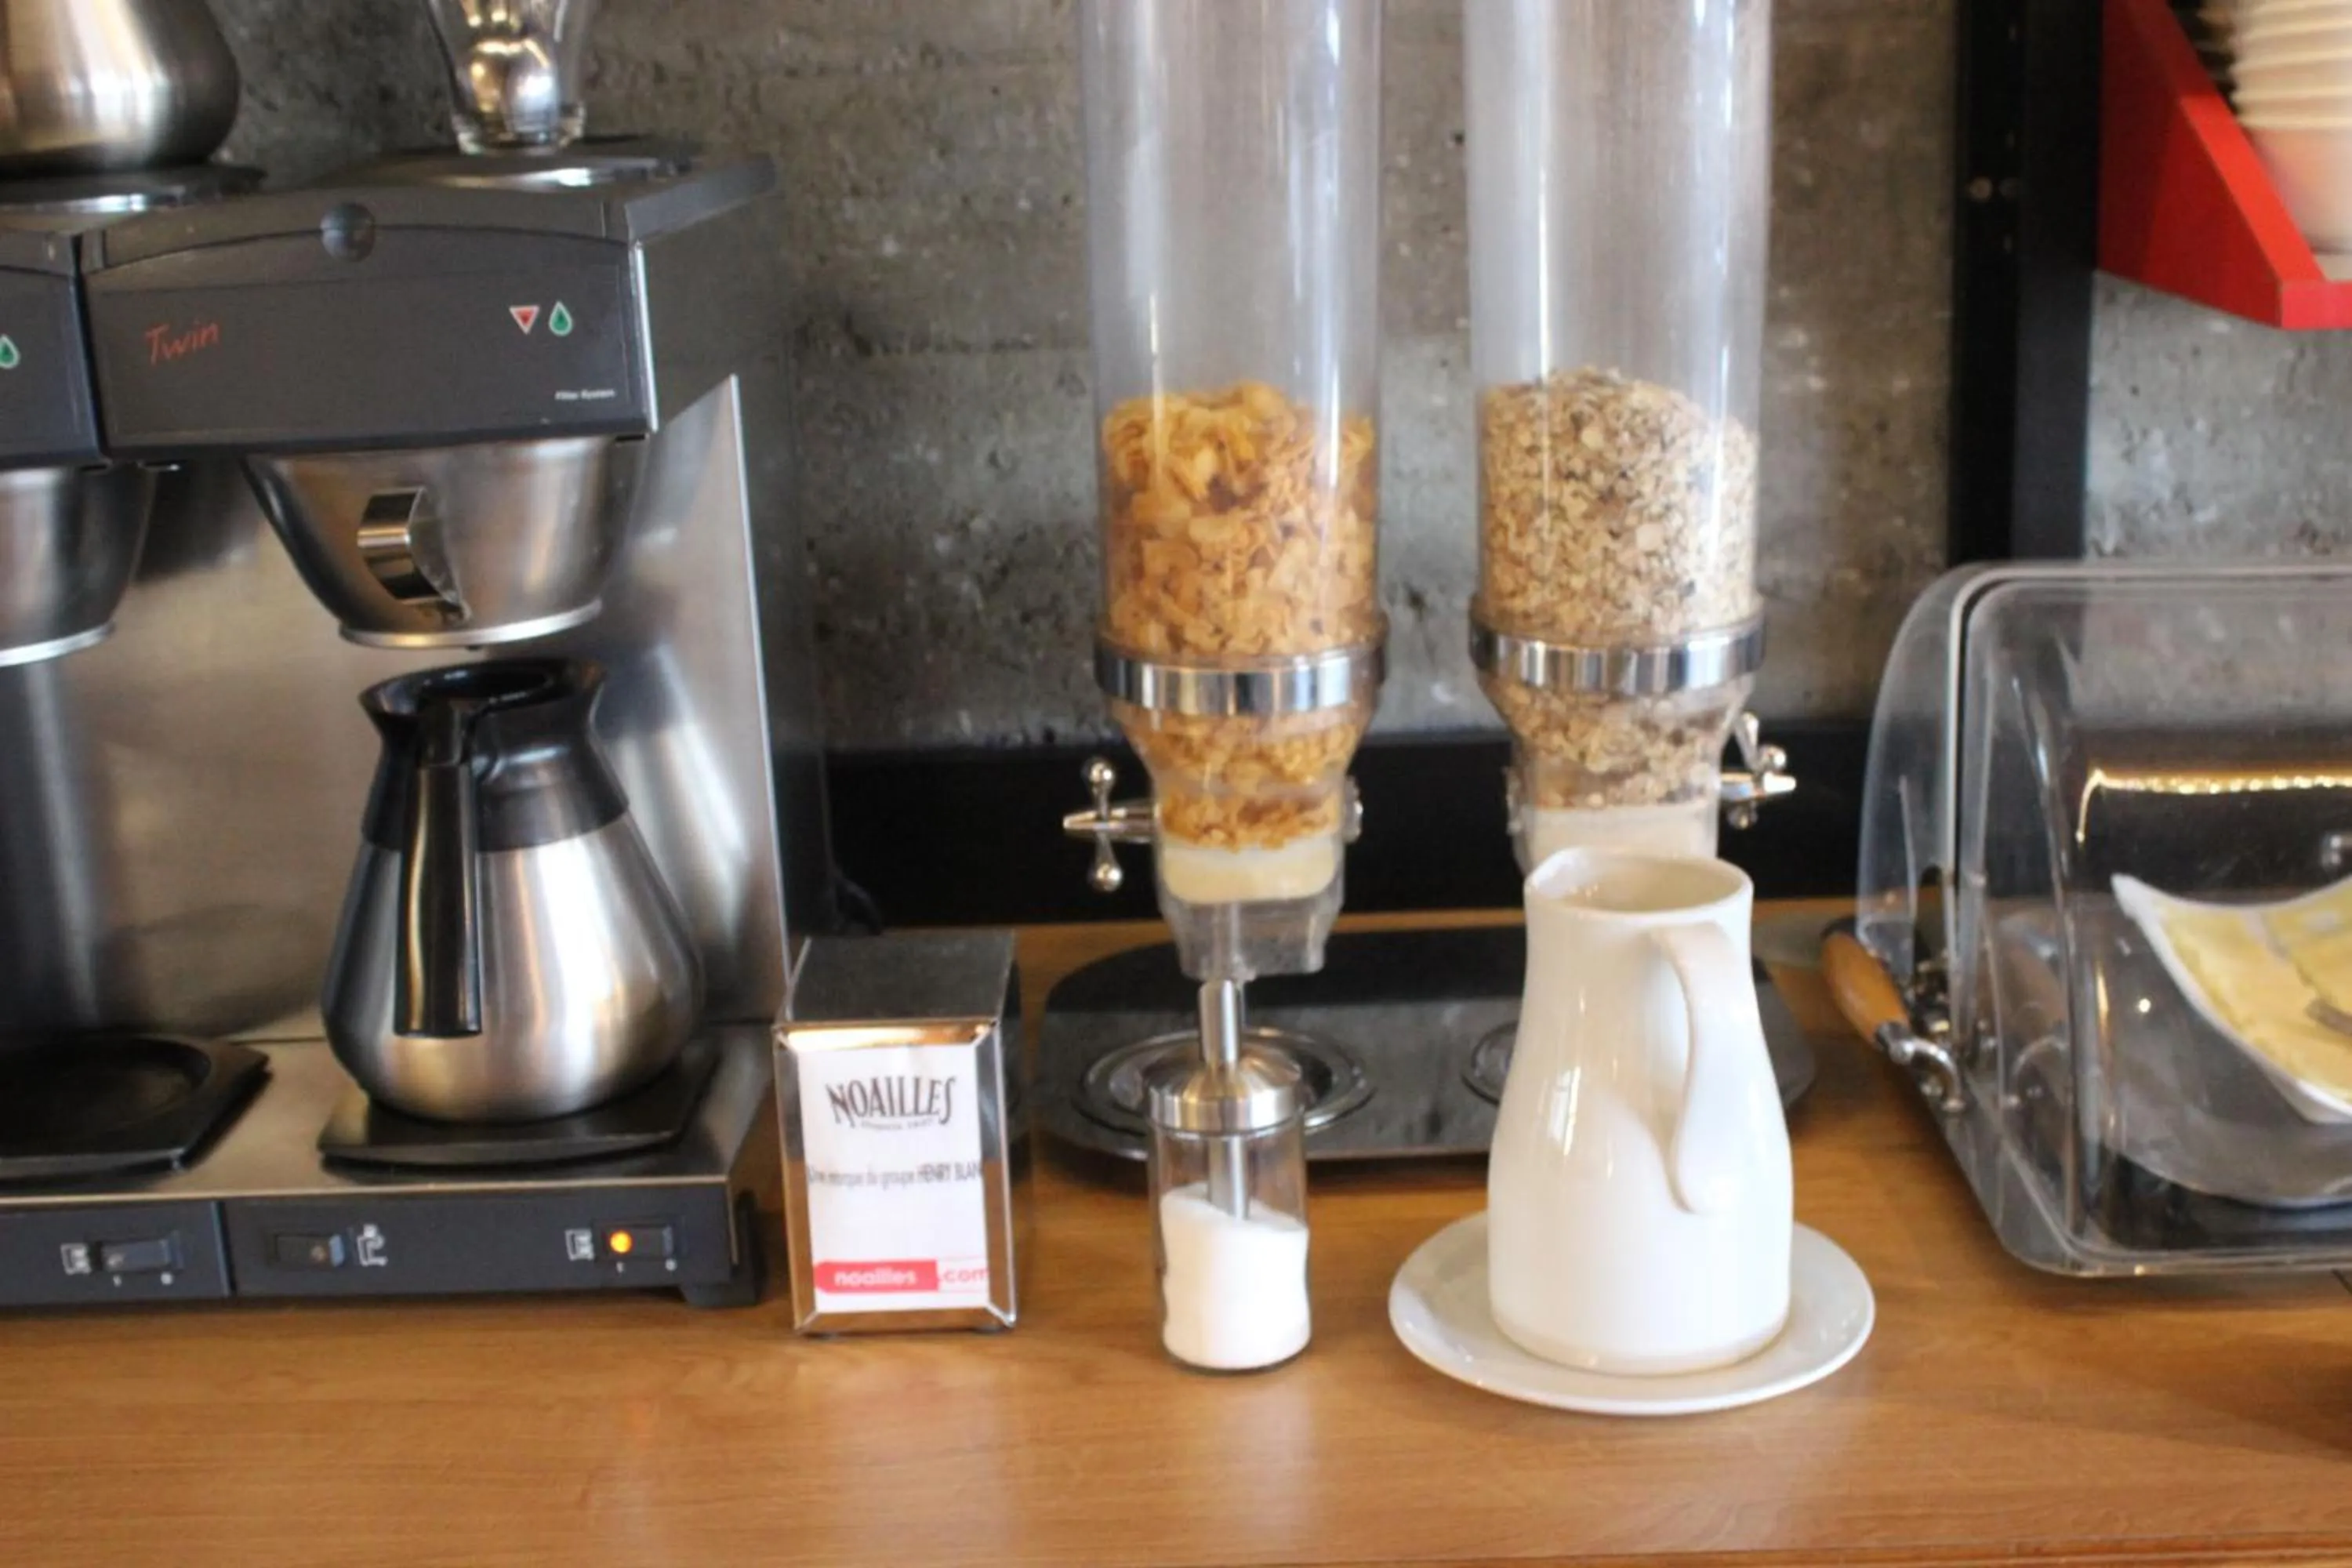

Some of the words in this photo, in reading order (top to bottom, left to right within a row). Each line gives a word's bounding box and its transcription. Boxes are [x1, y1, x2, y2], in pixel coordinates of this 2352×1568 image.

[146, 321, 219, 365] Twin
[825, 1075, 956, 1127] NOAILLES
[833, 1267, 916, 1287] noailles
